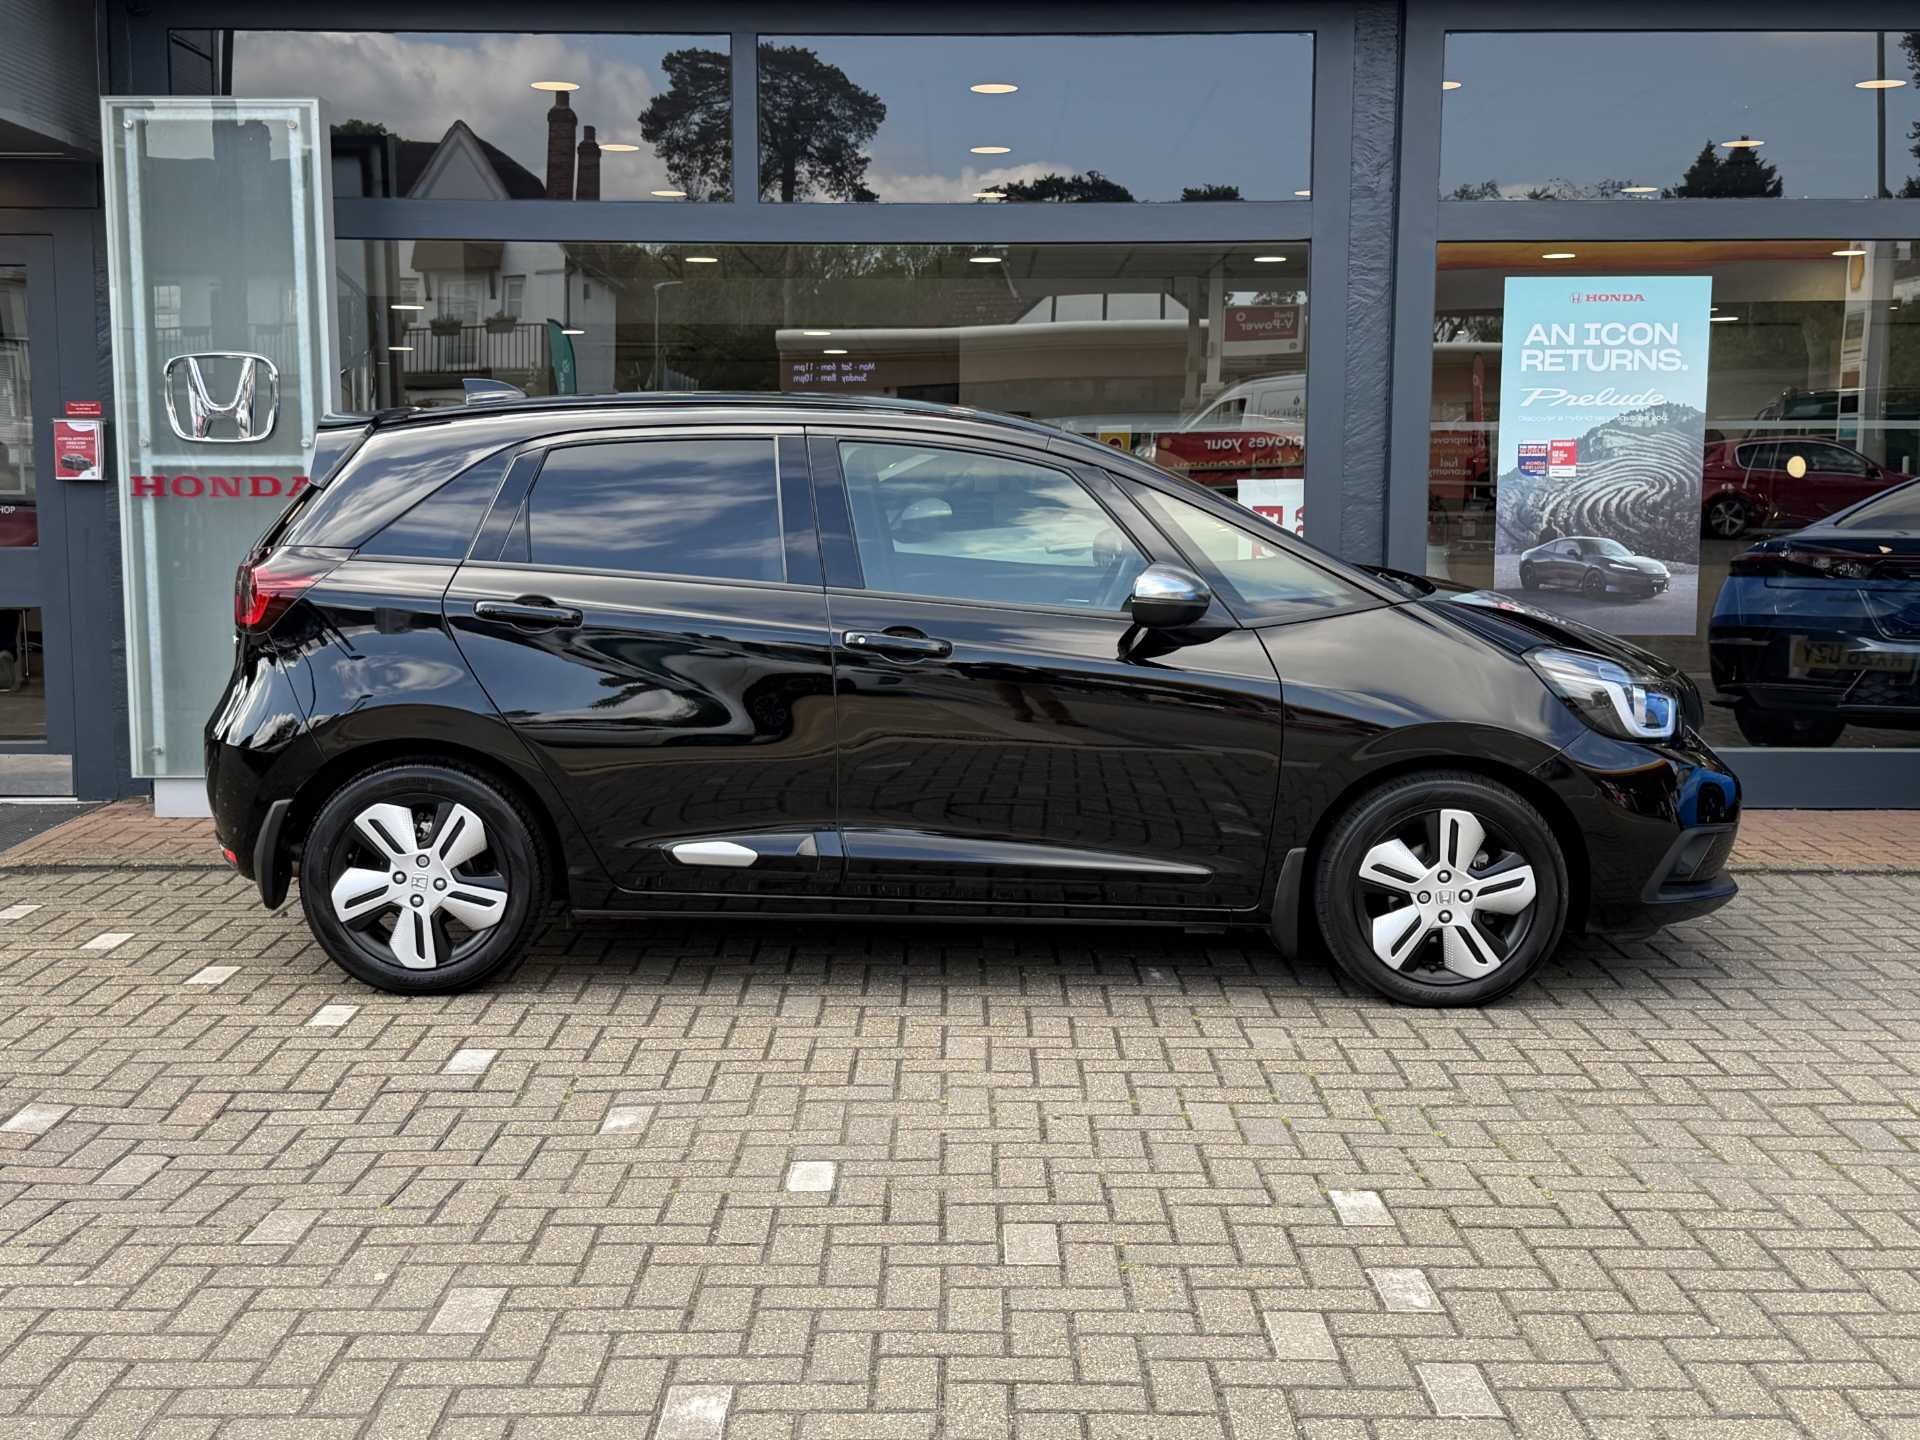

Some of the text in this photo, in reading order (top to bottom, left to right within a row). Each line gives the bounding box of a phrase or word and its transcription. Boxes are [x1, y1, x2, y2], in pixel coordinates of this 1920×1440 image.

[1585, 293, 1645, 302] HONDA
[1523, 322, 1679, 346] AN ICON
[1520, 348, 1689, 372] RETURNS.
[1520, 387, 1665, 407] Prelude
